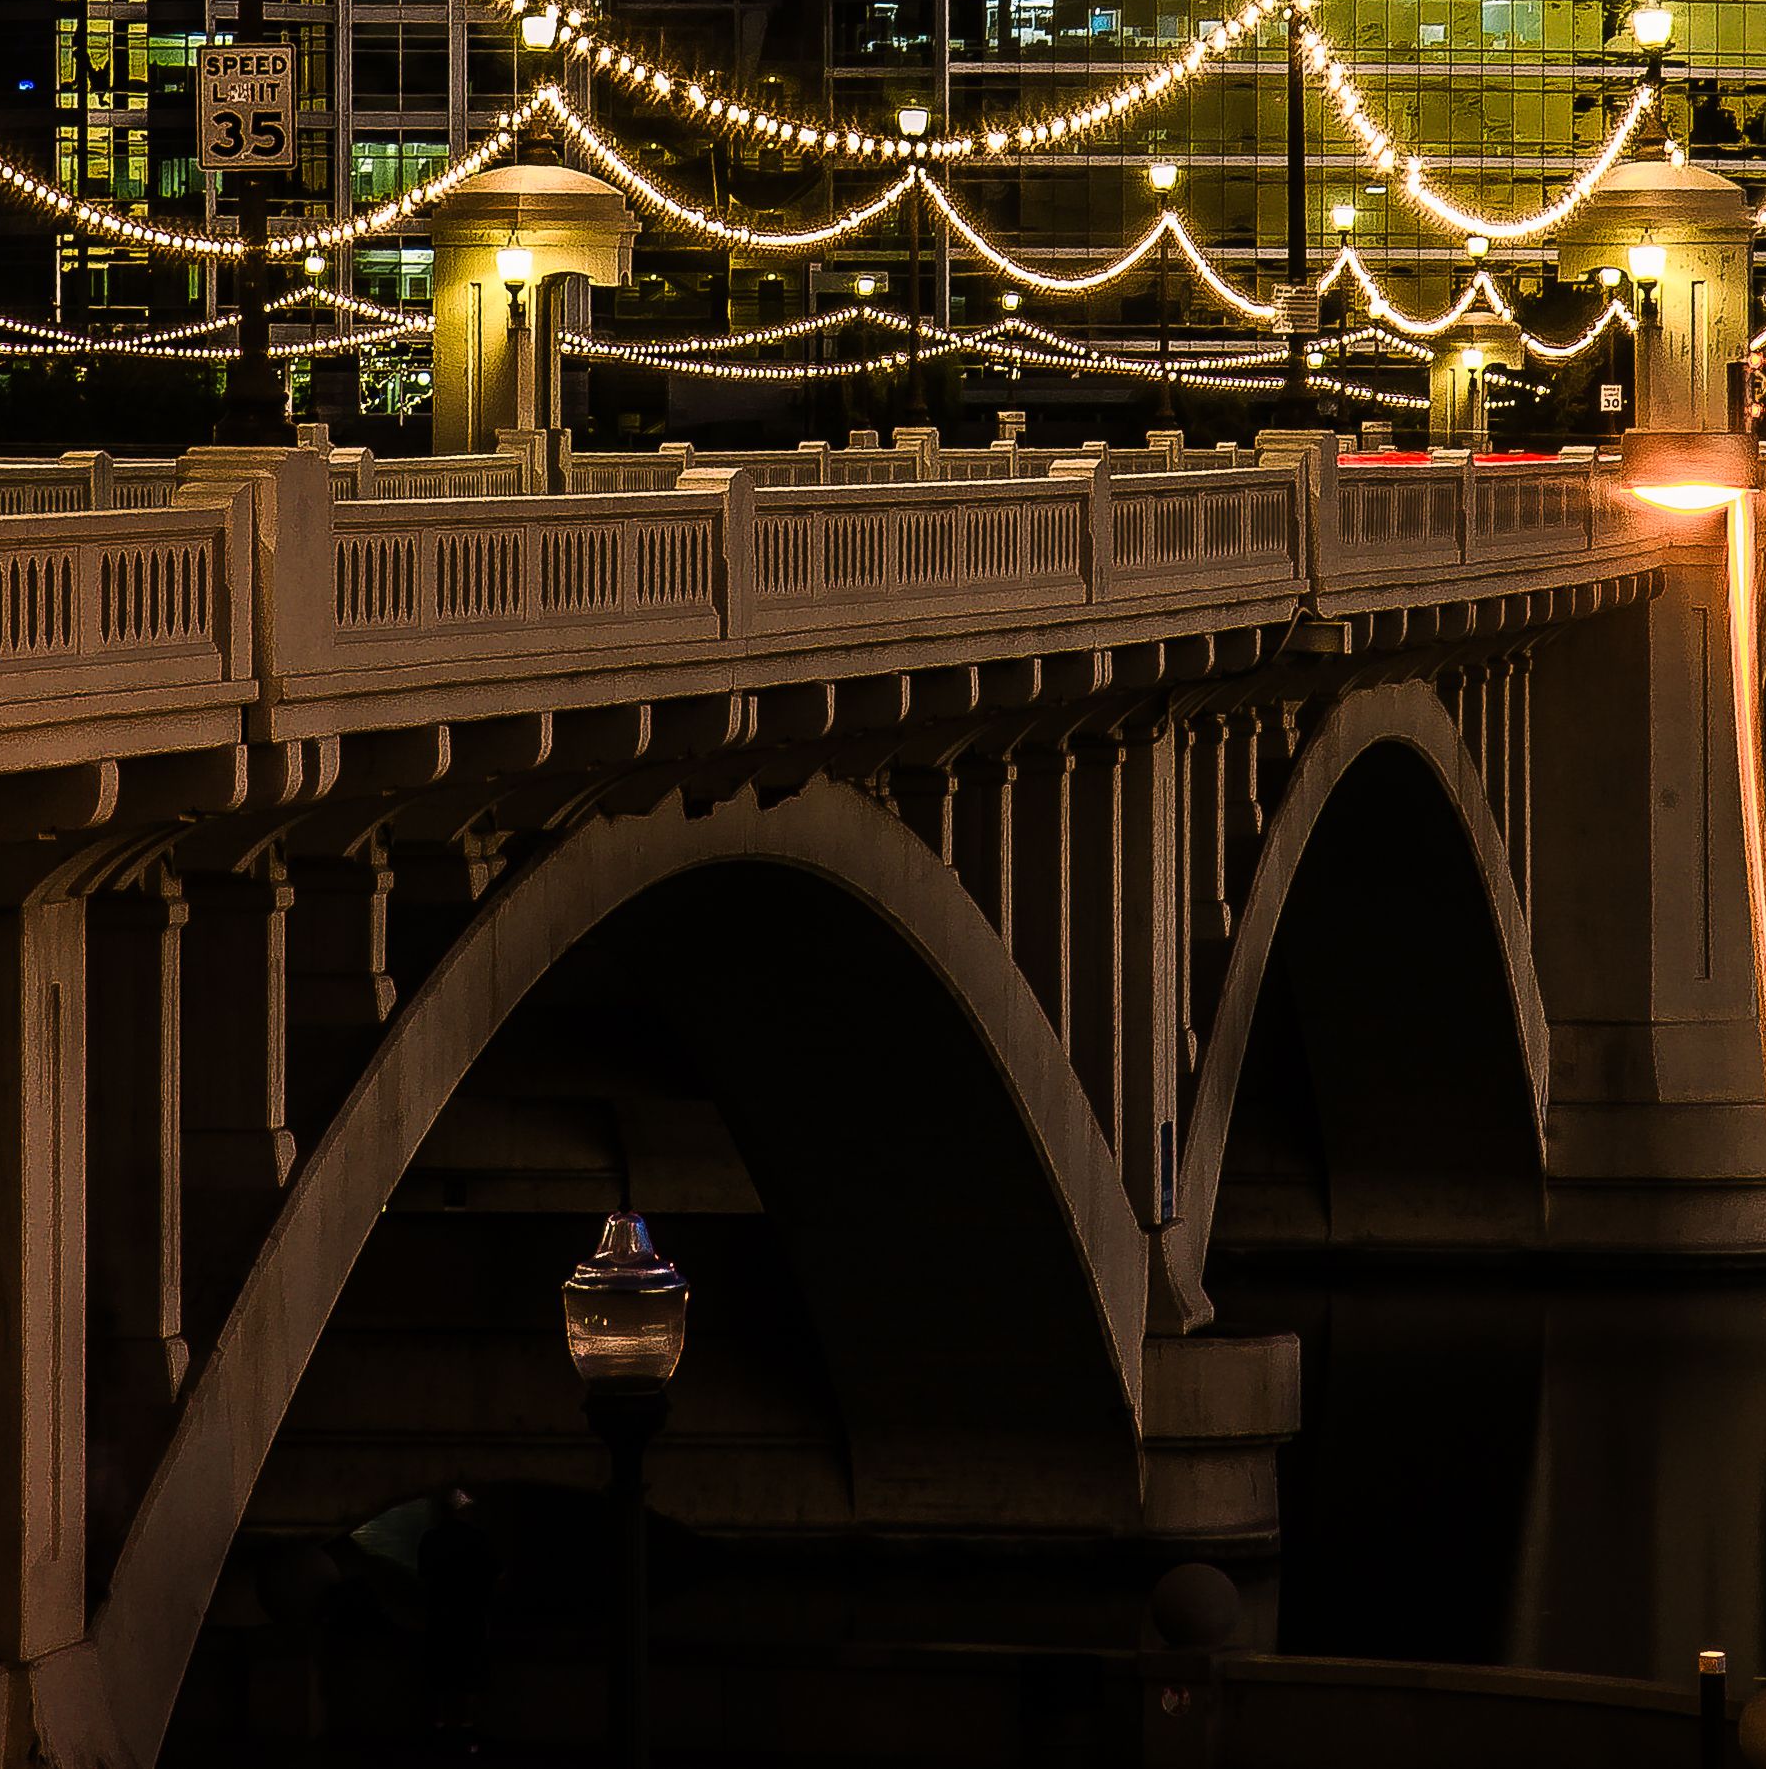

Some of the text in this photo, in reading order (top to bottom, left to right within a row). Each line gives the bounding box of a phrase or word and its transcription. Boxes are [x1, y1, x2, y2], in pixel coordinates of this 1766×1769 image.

[206, 55, 288, 76] SPEED
[209, 110, 287, 159] 35
[1603, 398, 1620, 409] 30
